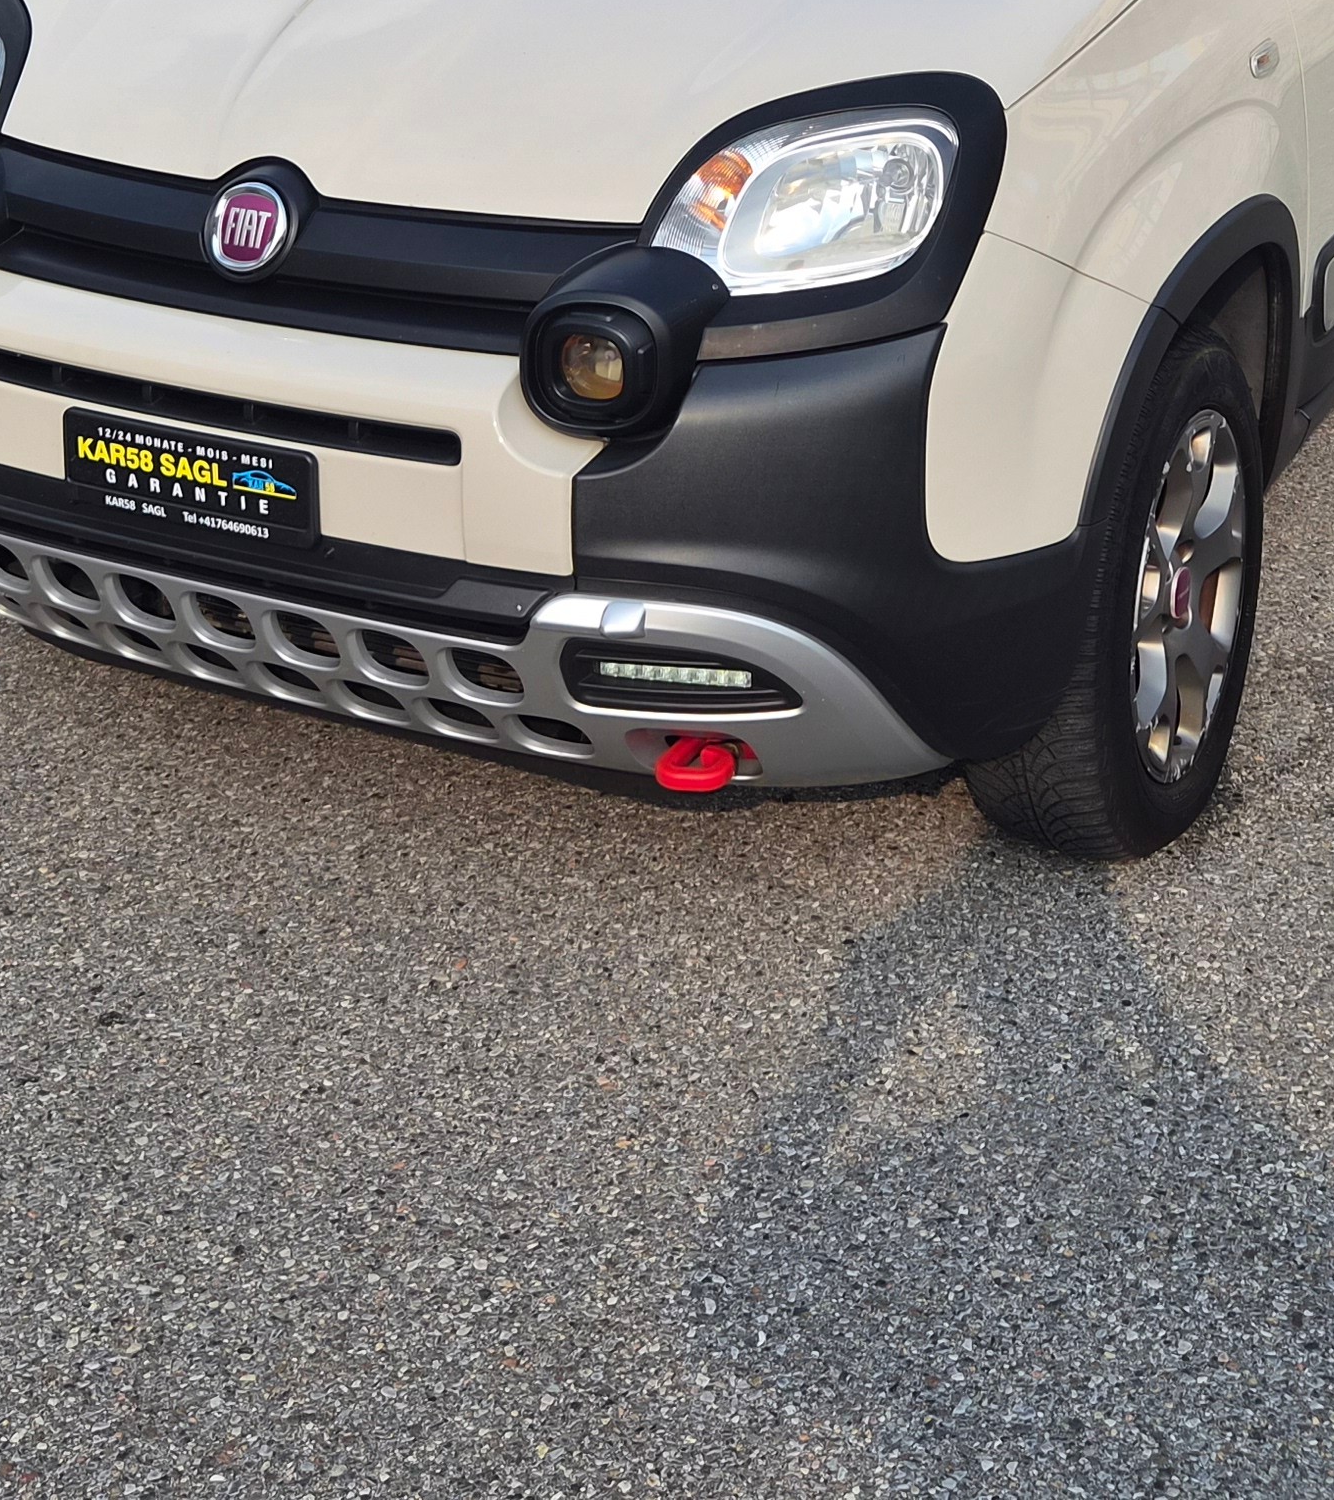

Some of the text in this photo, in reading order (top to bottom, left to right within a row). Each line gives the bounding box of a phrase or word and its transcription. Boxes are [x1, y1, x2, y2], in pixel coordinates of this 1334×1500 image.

[224, 207, 272, 249] FIAT
[77, 436, 227, 487] KAR58 SAGL
[98, 427, 132, 443] 12/24
[135, 434, 184, 453] MONATE
[196, 446, 228, 461] MOIS
[241, 455, 273, 469] MESI
[105, 469, 269, 514] GARANTIE
[105, 495, 269, 539] KAR58 SAGL Tel +41764690613
